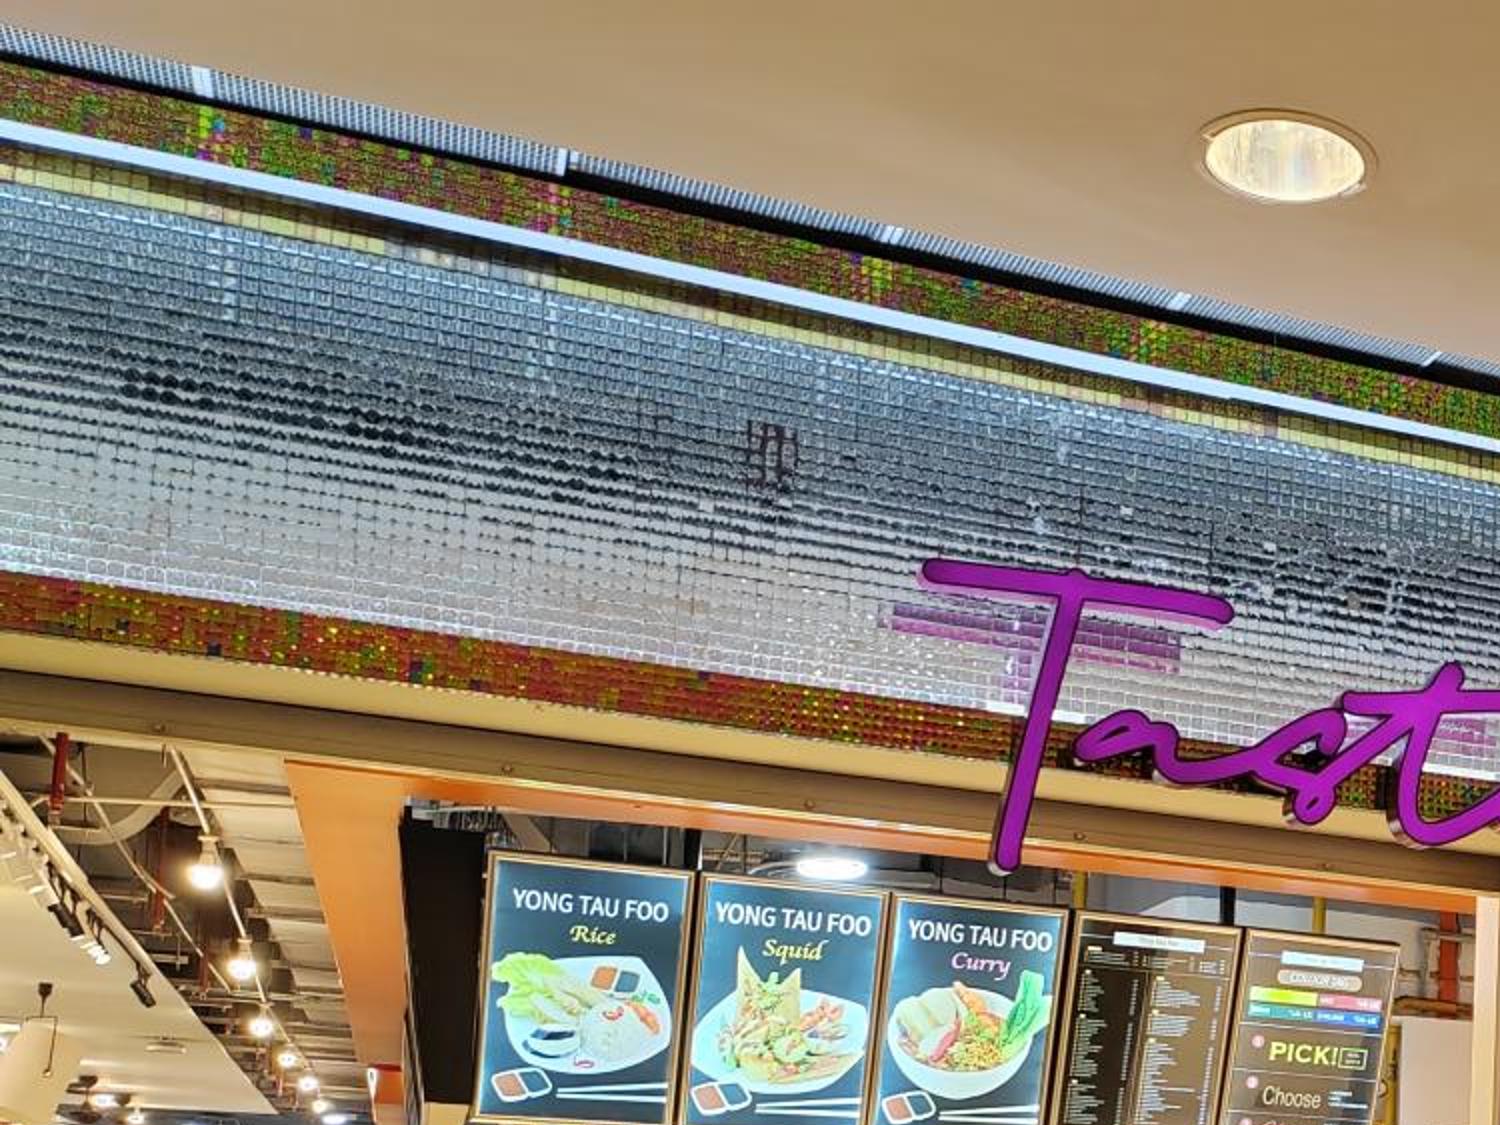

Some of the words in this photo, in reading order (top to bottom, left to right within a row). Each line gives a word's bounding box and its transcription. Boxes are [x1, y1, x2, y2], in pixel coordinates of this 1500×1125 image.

[513, 888, 574, 914] YONG
[579, 895, 620, 917] TAU
[625, 900, 669, 922] FOO
[715, 901, 776, 927] YONG
[781, 909, 822, 931] TAU
[827, 913, 872, 937] FOO
[569, 925, 616, 945] Rice
[908, 918, 965, 943] YONG
[970, 925, 1007, 947] TAU
[1011, 929, 1053, 952] FOO
[762, 939, 829, 966] Squid
[951, 952, 1011, 981] Curry
[1262, 1086, 1321, 1109] Choose
